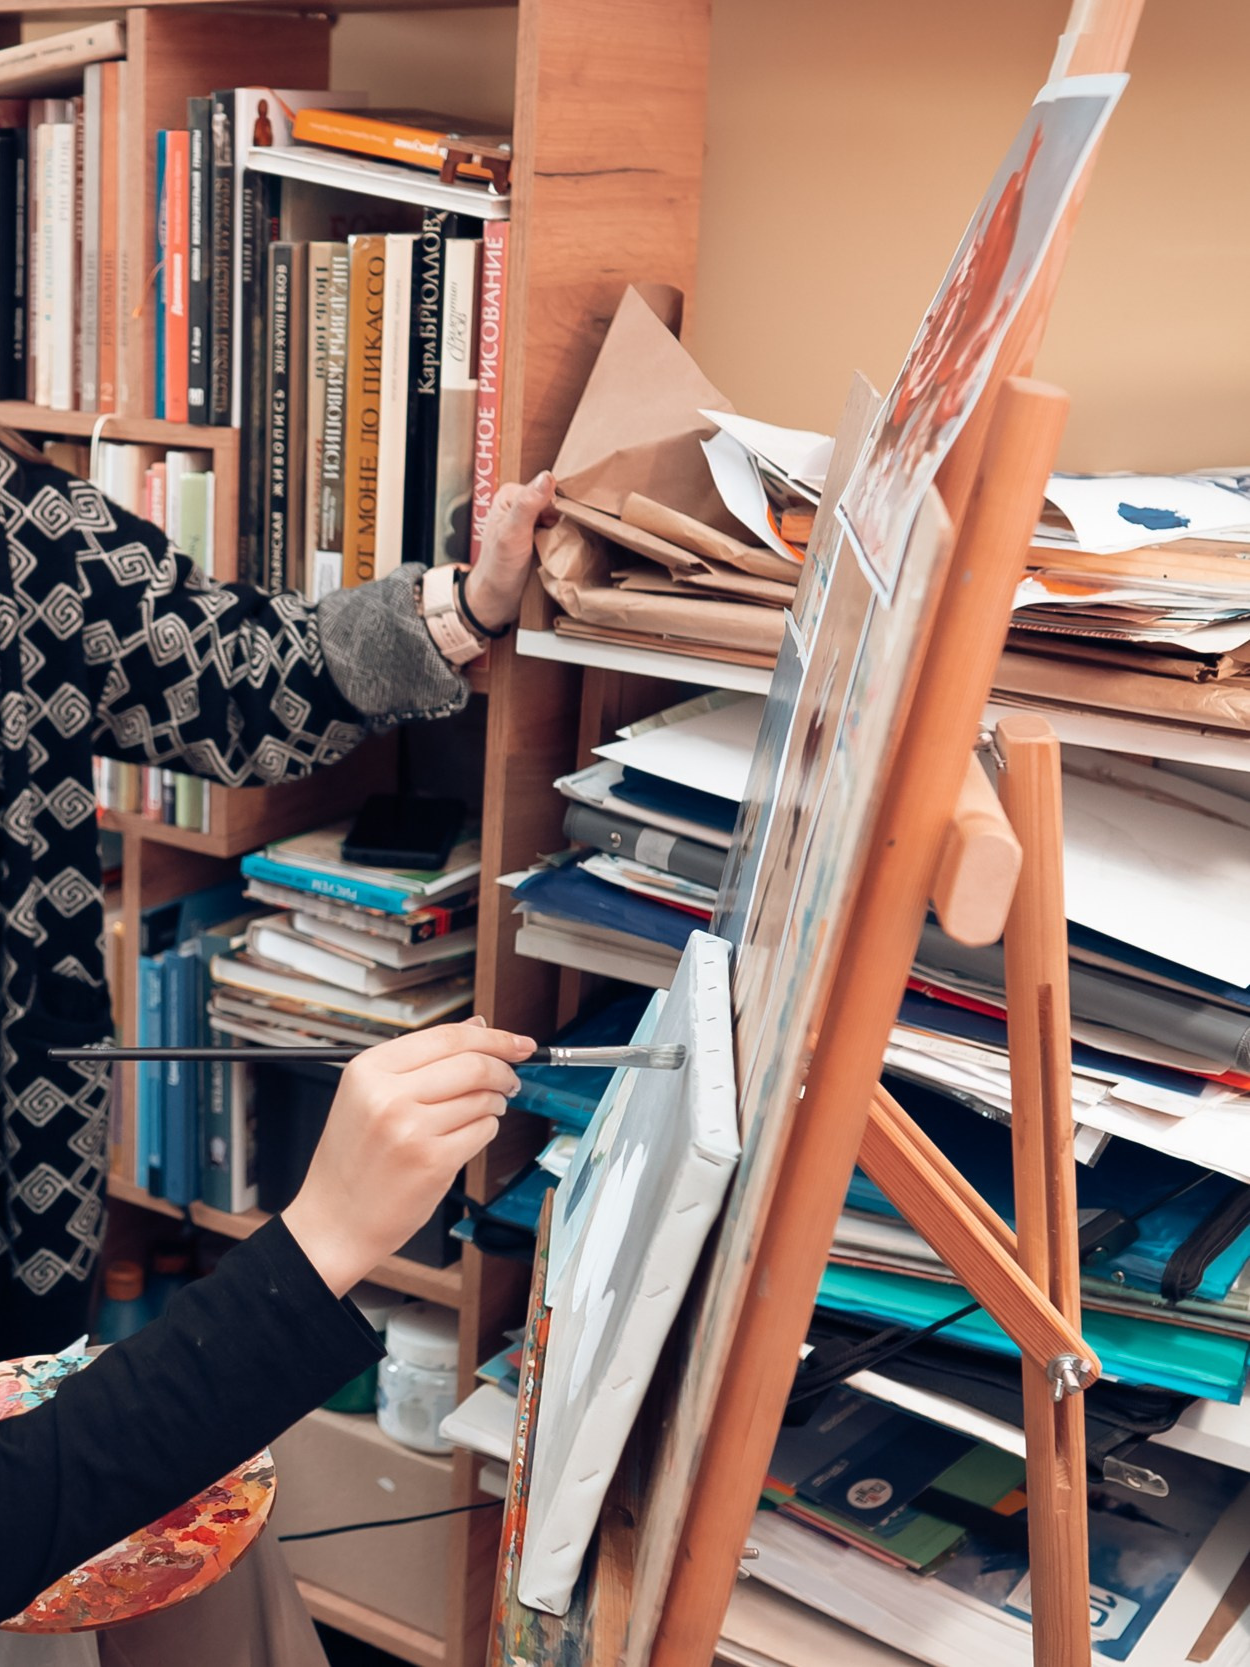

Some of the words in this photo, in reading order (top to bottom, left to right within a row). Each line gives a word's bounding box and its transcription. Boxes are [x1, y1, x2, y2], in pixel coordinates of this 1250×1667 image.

[274, 263, 288, 312] ВЕКОВ
[328, 256, 349, 356] ШЕДЕВРЫ
[363, 256, 386, 396] ПИКАССО
[419, 218, 442, 339] БРЮЛЛОВ
[479, 236, 504, 393] РИСОВАНИЕ
[323, 360, 344, 480] ЖИВОПИСИ
[417, 342, 440, 395] Карл
[272, 388, 286, 498] ЖИВОПИСЬ
[361, 408, 380, 446] ДО
[472, 406, 496, 542] ИСКУСНОЕ
[358, 456, 379, 537] МОНЕ
[357, 544, 376, 581] ОТ
